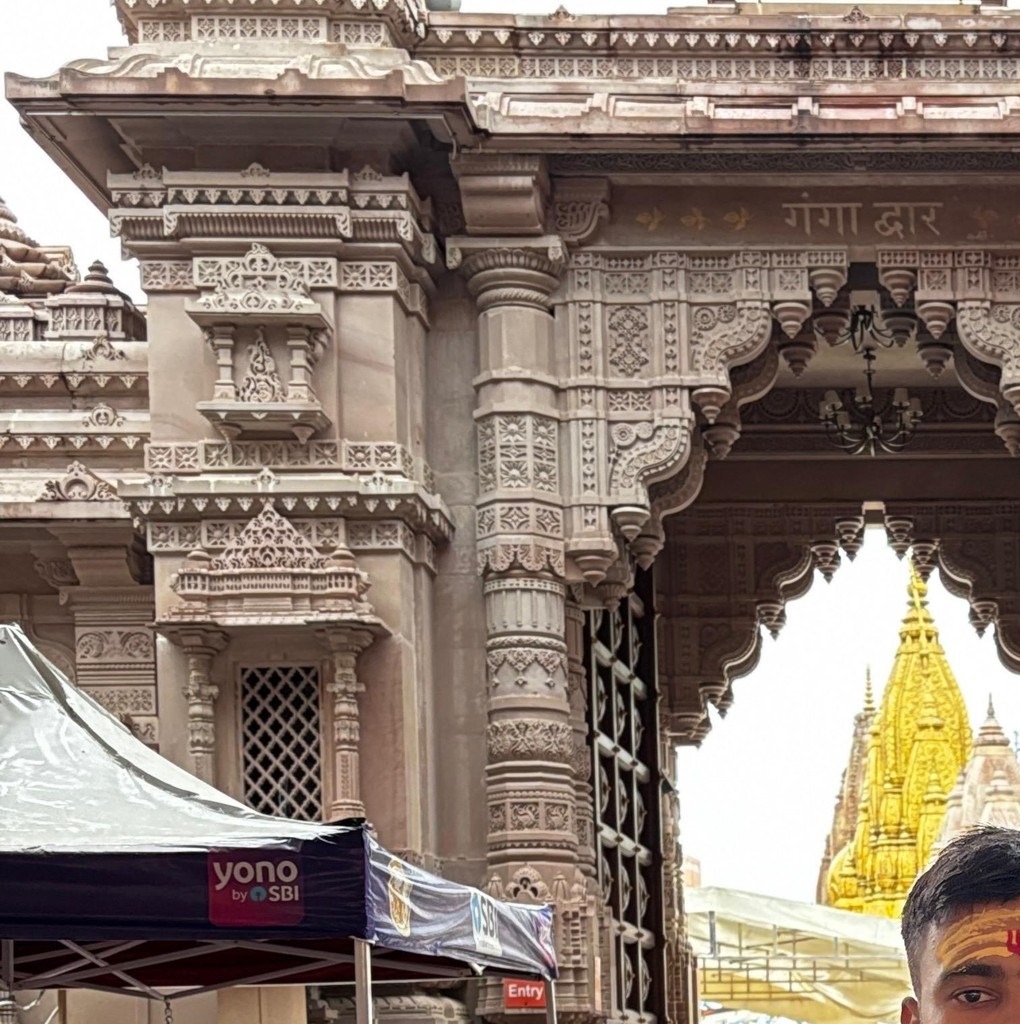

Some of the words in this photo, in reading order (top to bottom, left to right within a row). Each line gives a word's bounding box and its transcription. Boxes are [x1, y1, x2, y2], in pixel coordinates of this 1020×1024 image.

[782, 191, 863, 237] गंगा
[872, 202, 944, 239] द्वार
[213, 860, 298, 891] yono
[232, 889, 248, 902] by
[269, 886, 299, 902] SBI
[508, 984, 544, 1001] Entry
